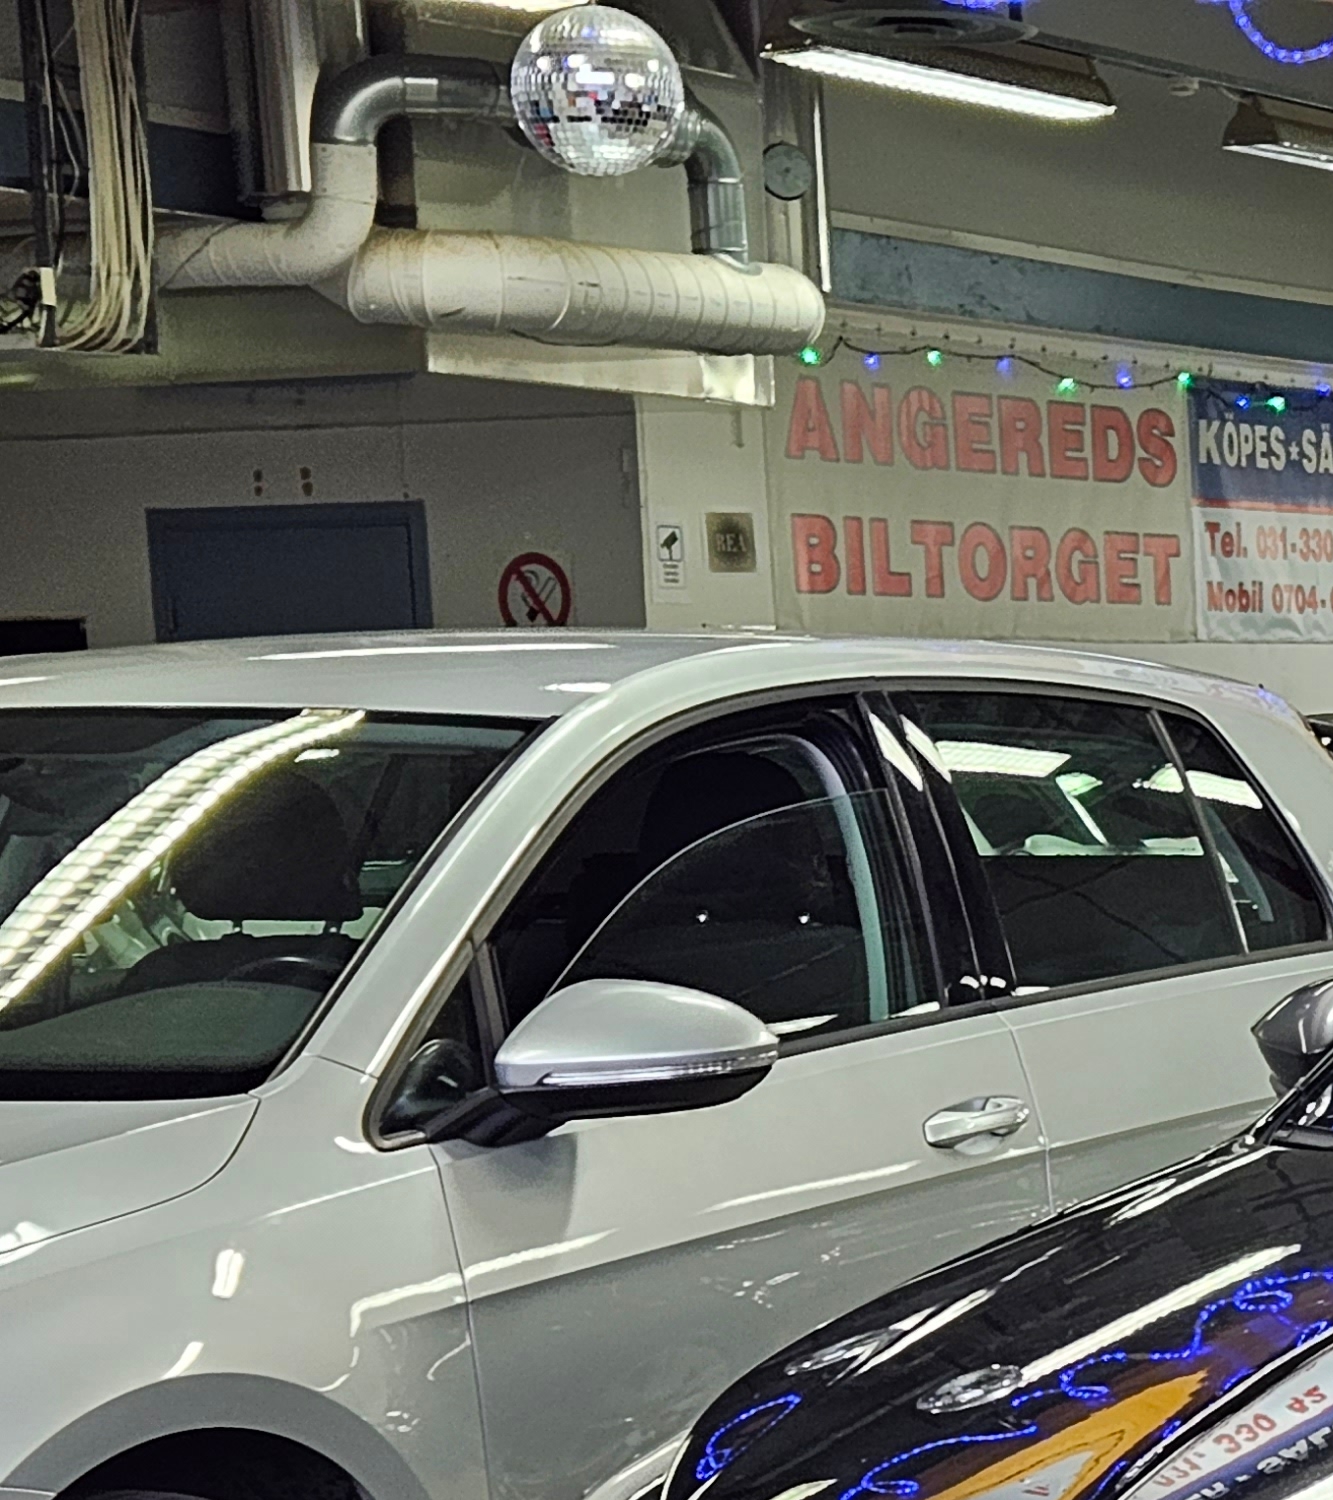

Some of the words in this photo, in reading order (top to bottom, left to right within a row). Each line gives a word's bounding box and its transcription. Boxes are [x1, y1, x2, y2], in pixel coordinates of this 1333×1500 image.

[784, 373, 1178, 488] ANGEREDS
[1198, 411, 1287, 471] KÖPES
[790, 512, 1181, 606] BILTORGET
[1203, 520, 1248, 559] Tel.
[1206, 580, 1264, 614] Mobil
